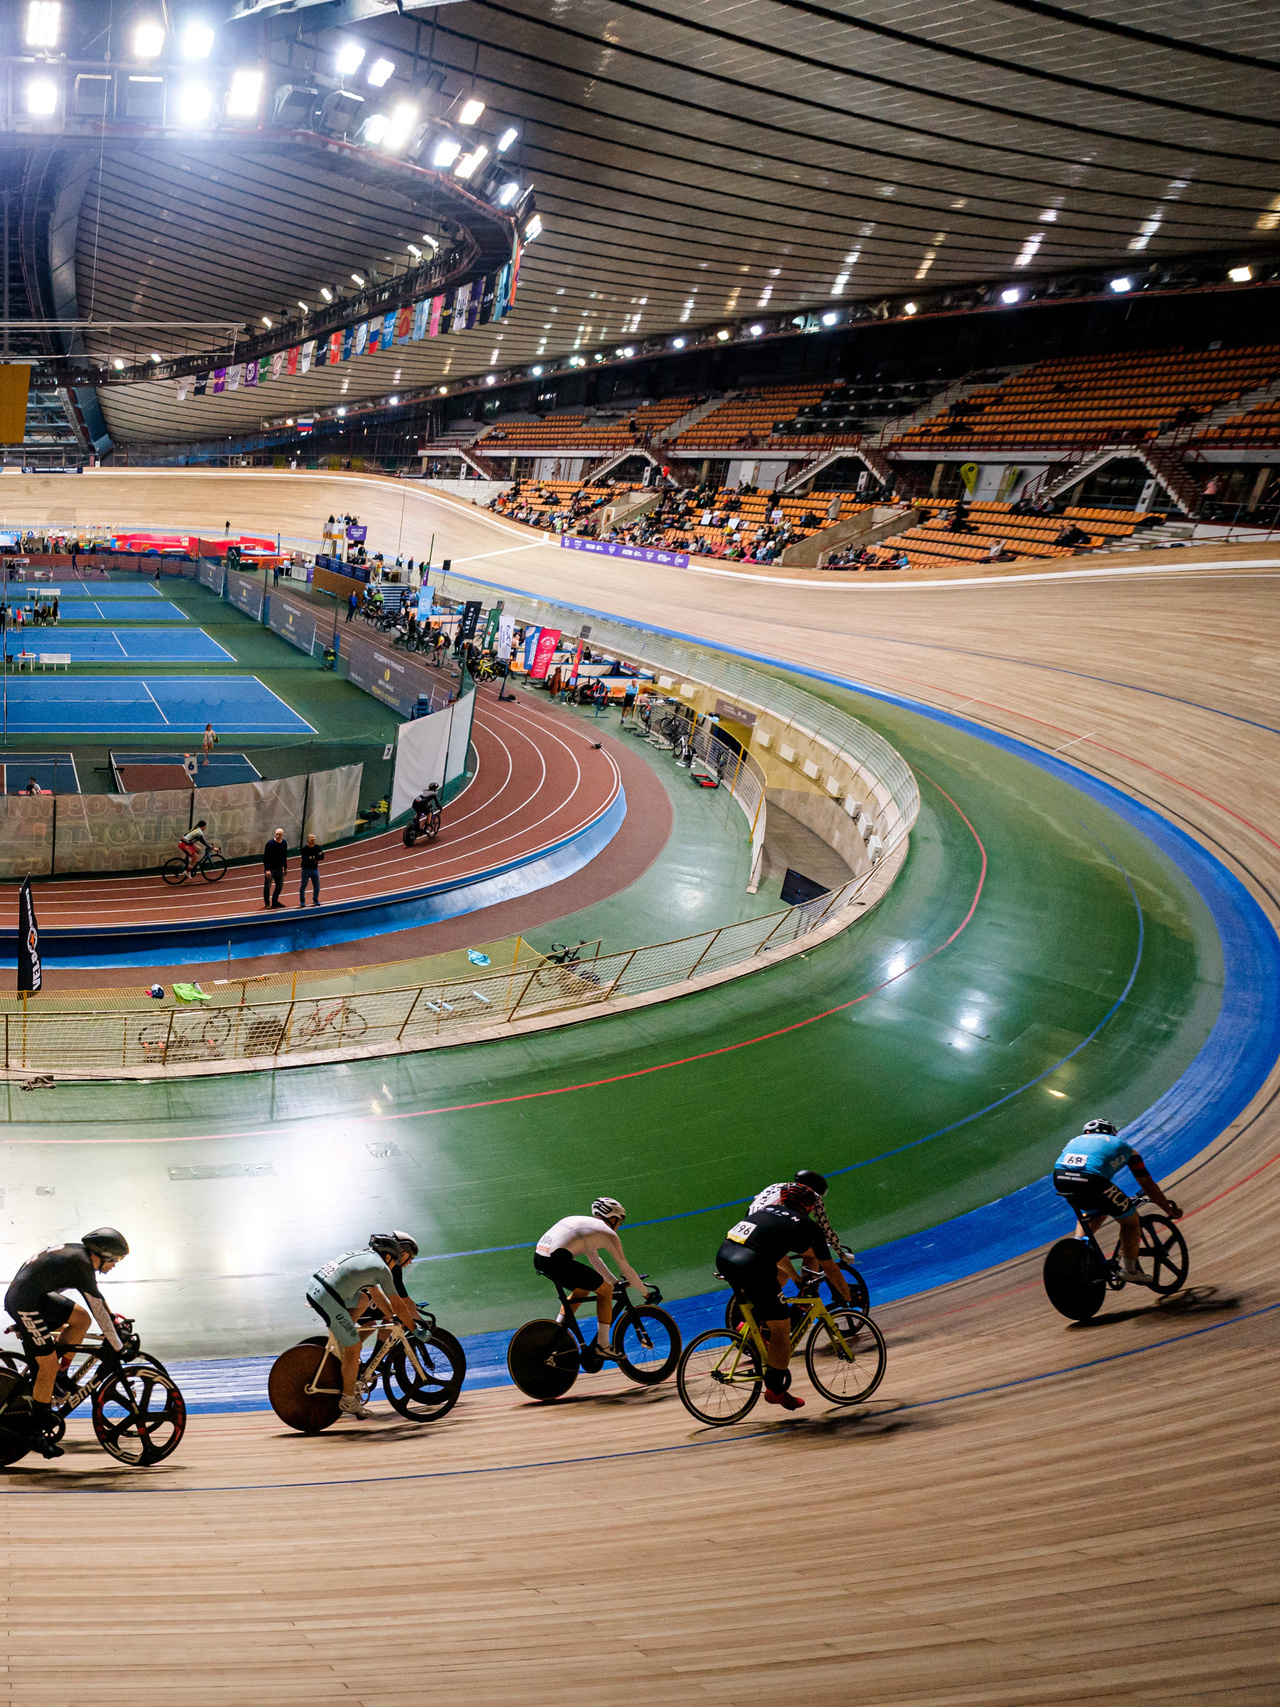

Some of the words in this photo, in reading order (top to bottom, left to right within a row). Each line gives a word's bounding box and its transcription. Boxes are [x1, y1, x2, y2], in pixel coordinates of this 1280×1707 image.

[464, 607, 475, 634] LEGION
[188, 762, 195, 772] 6
[1067, 1156, 1084, 1165] 68
[1109, 1154, 1127, 1171] RCA
[1103, 1185, 1130, 1212] RCA
[733, 1224, 751, 1236] 196
[68, 1374, 102, 1409] BMC
